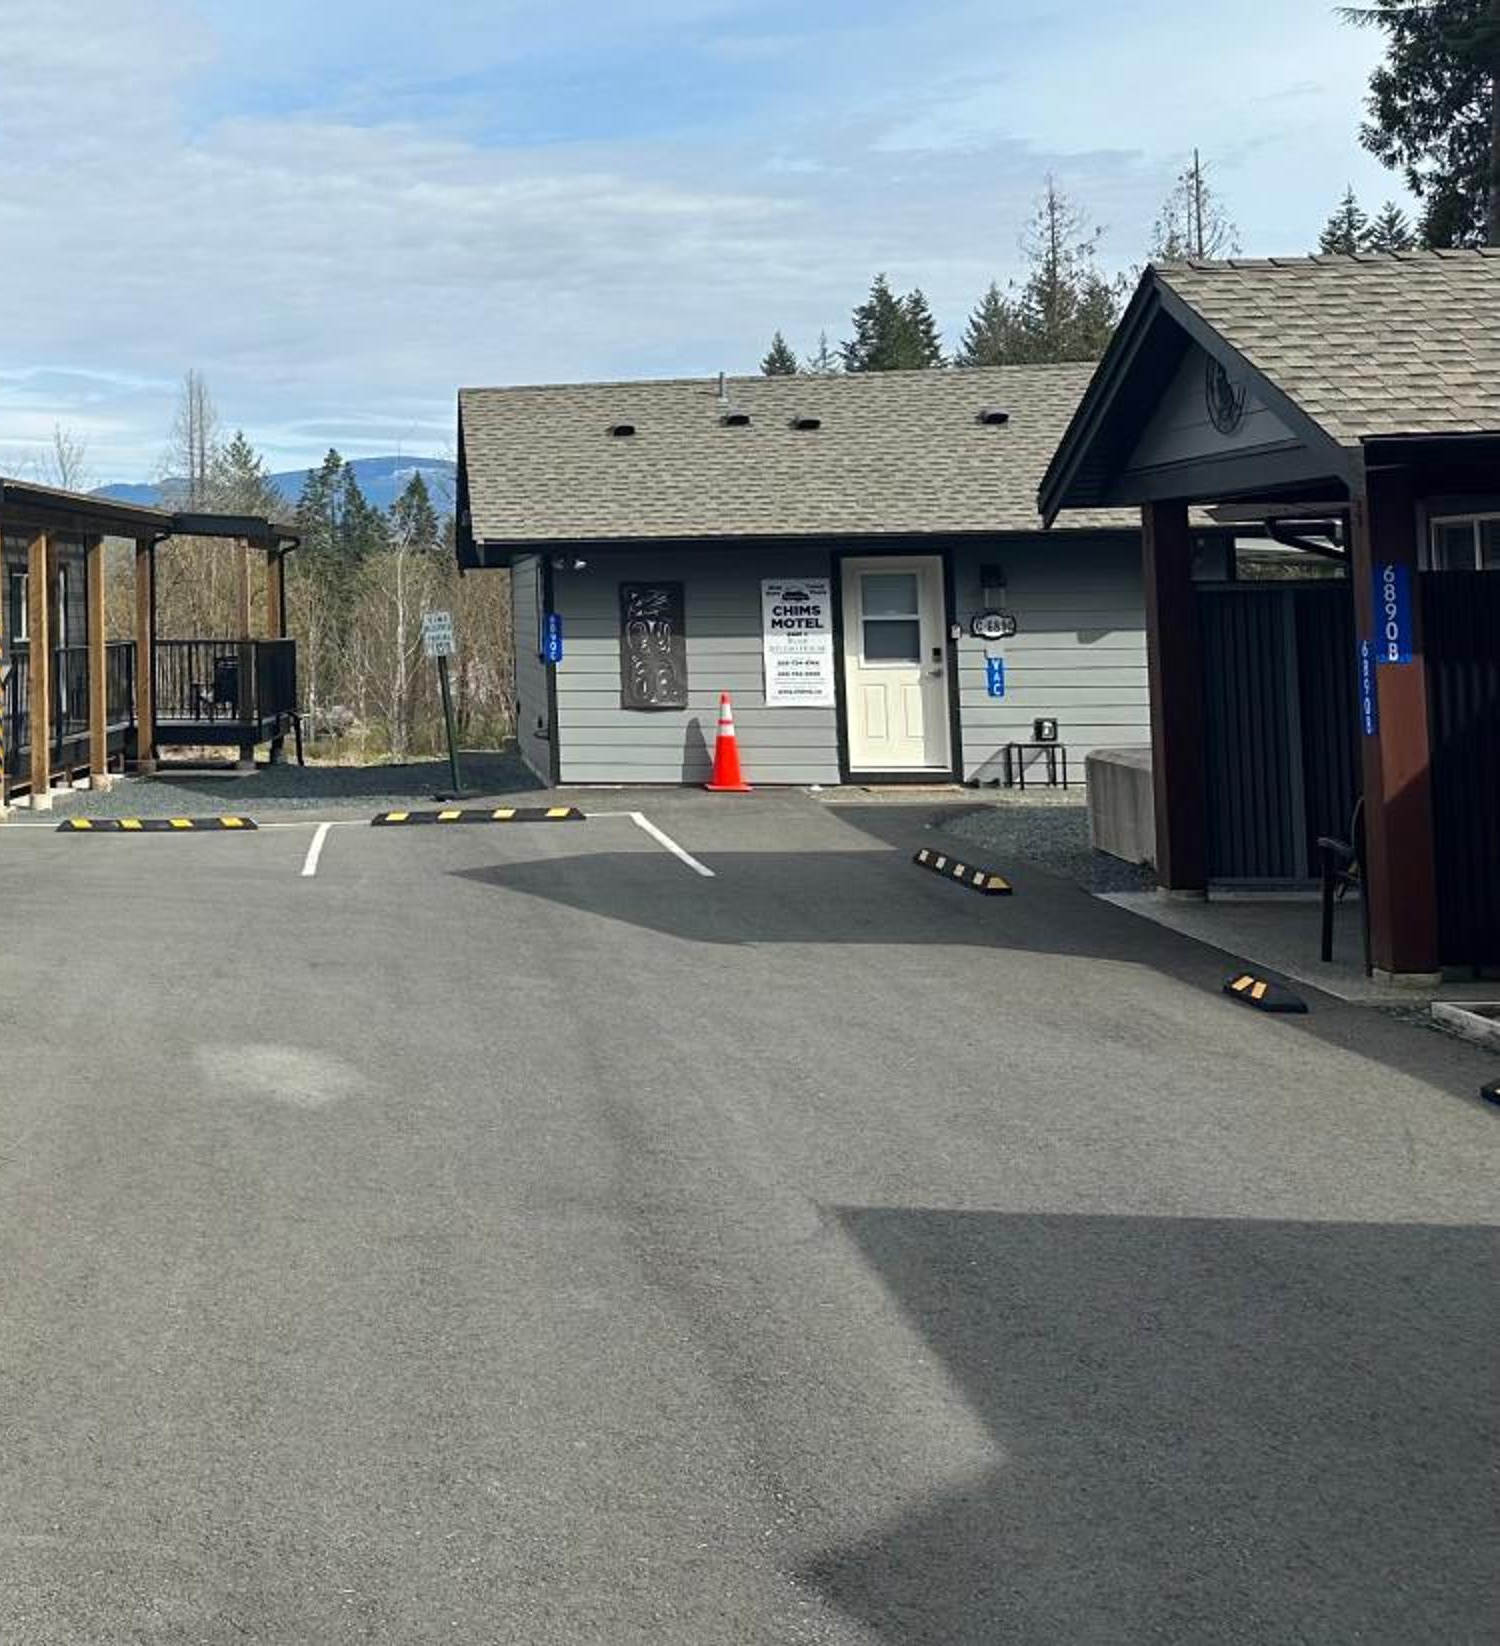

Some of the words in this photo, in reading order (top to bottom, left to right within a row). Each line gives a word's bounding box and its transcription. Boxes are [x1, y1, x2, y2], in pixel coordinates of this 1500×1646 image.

[772, 605, 821, 617] CHIMS
[1383, 565, 1399, 661] 6890B
[771, 618, 824, 629] MOTEL
